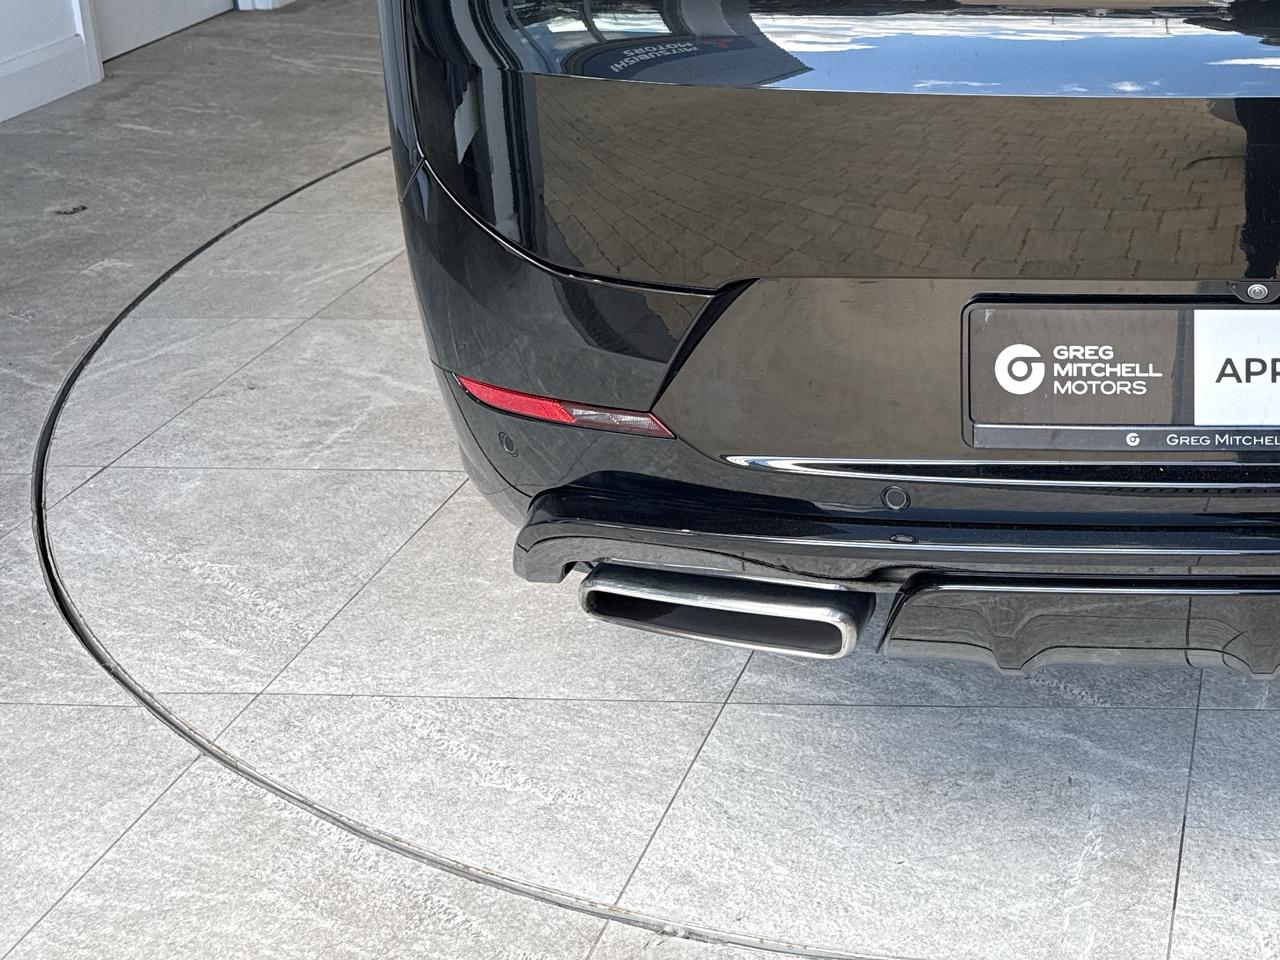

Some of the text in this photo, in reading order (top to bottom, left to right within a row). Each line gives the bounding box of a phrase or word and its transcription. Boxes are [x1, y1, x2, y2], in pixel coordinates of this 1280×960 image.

[623, 41, 694, 57] MOTORS
[610, 46, 699, 72] MITSUBISHI
[1053, 345, 1114, 360] GREG
[1053, 362, 1163, 377] MITCHELL
[1053, 380, 1148, 395] MOTORS
